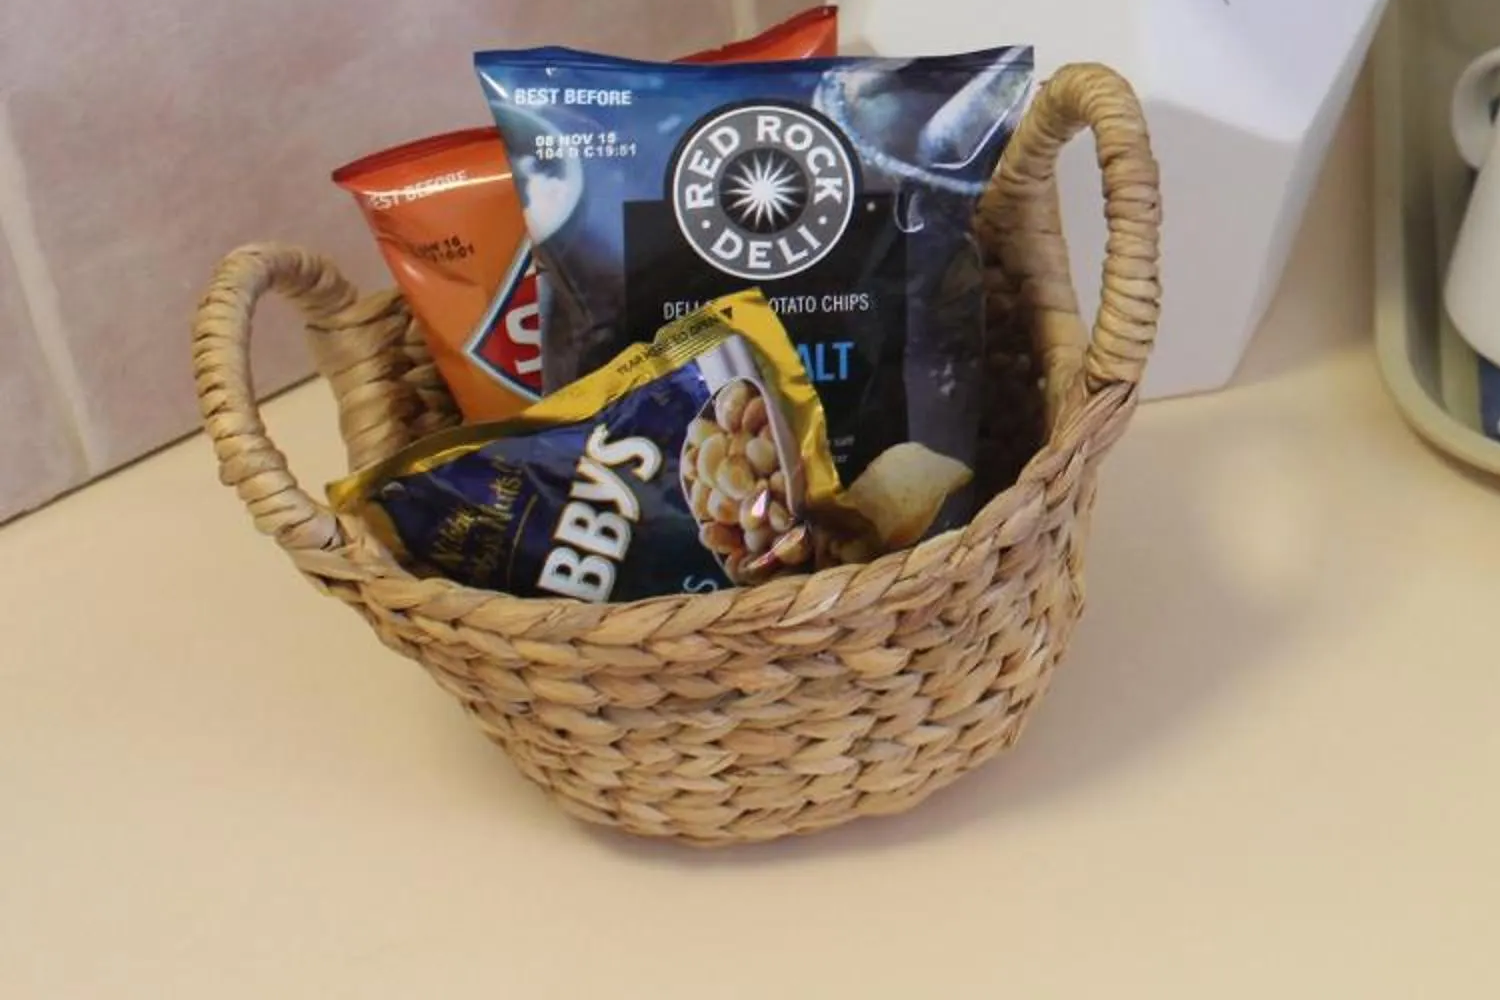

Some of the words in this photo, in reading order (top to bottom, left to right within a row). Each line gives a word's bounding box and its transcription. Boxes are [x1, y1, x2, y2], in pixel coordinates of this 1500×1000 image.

[514, 87, 560, 105] BEST
[563, 88, 633, 106] BEFORE
[559, 132, 594, 147] NOV
[685, 125, 741, 211] RED
[755, 115, 844, 205] ROCK
[711, 224, 822, 270] DELI
[768, 295, 817, 313] OTATO
[821, 293, 870, 313] CHIPS
[796, 341, 855, 382] ALT
